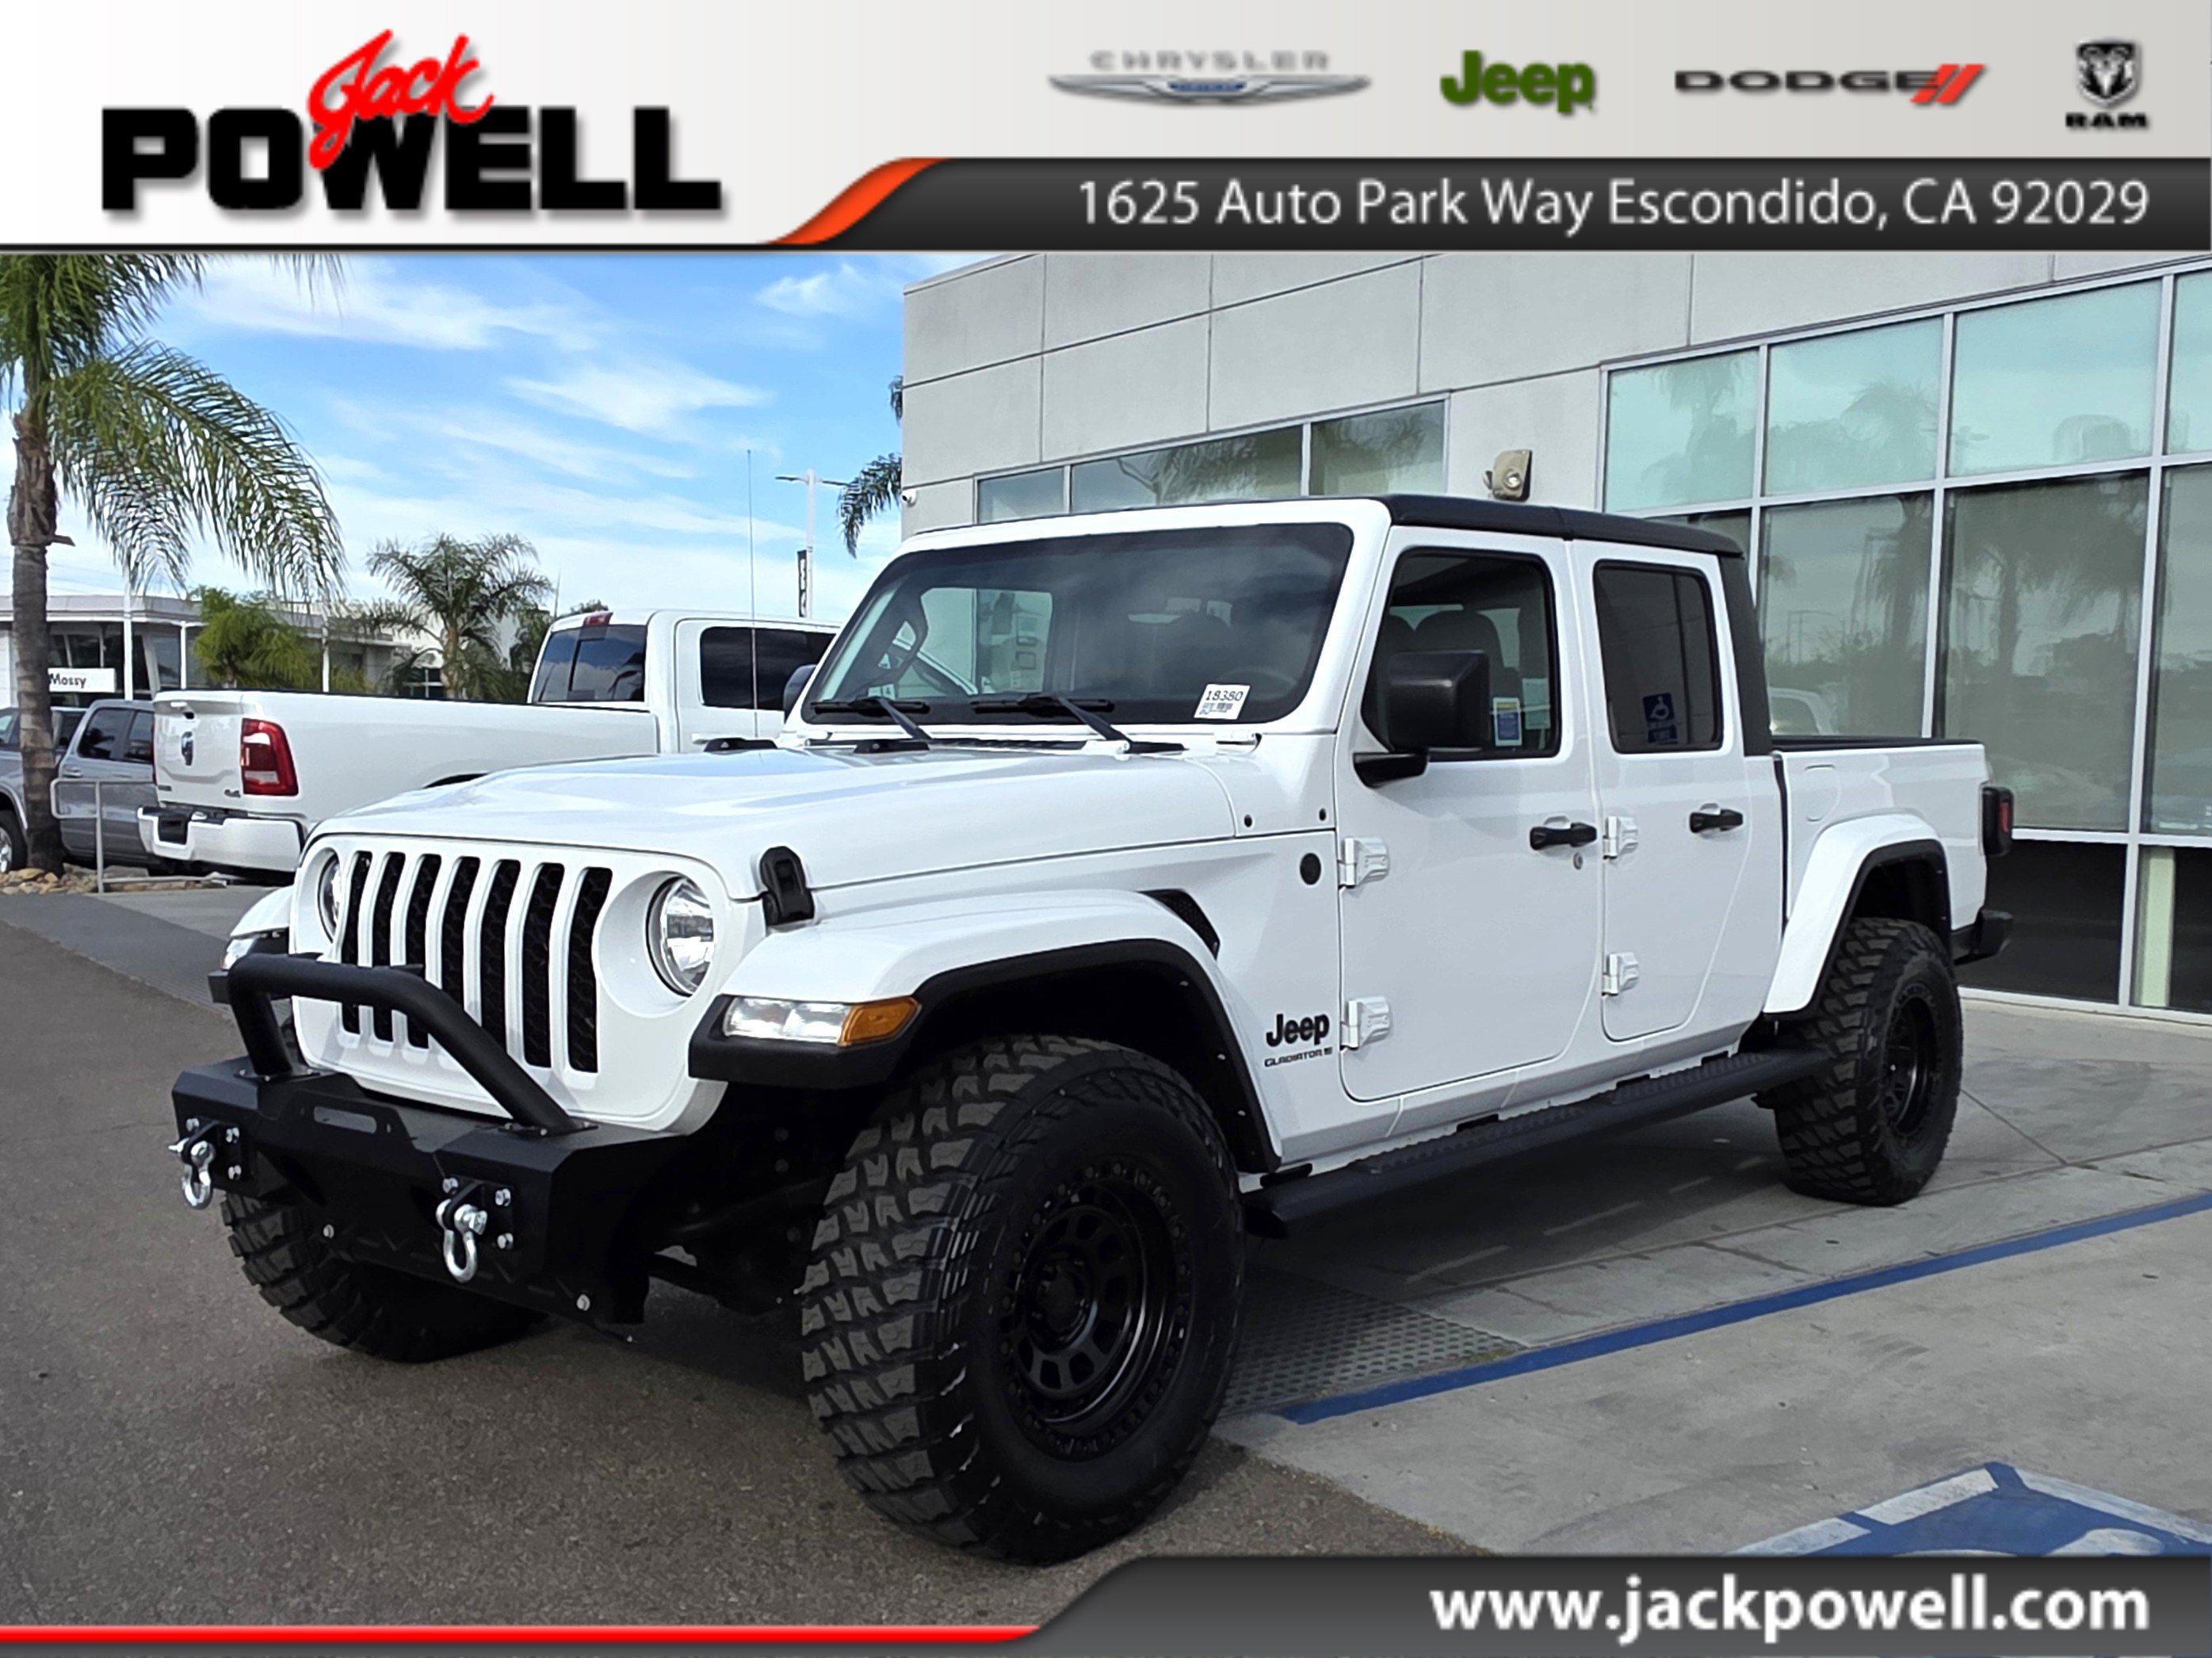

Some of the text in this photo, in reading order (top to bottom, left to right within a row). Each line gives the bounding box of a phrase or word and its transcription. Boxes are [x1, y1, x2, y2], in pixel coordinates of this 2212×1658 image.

[48, 673, 86, 689] Mossy
[1266, 1014, 1330, 1047] Jeep
[1264, 1049, 1323, 1068] GLADIATOR
